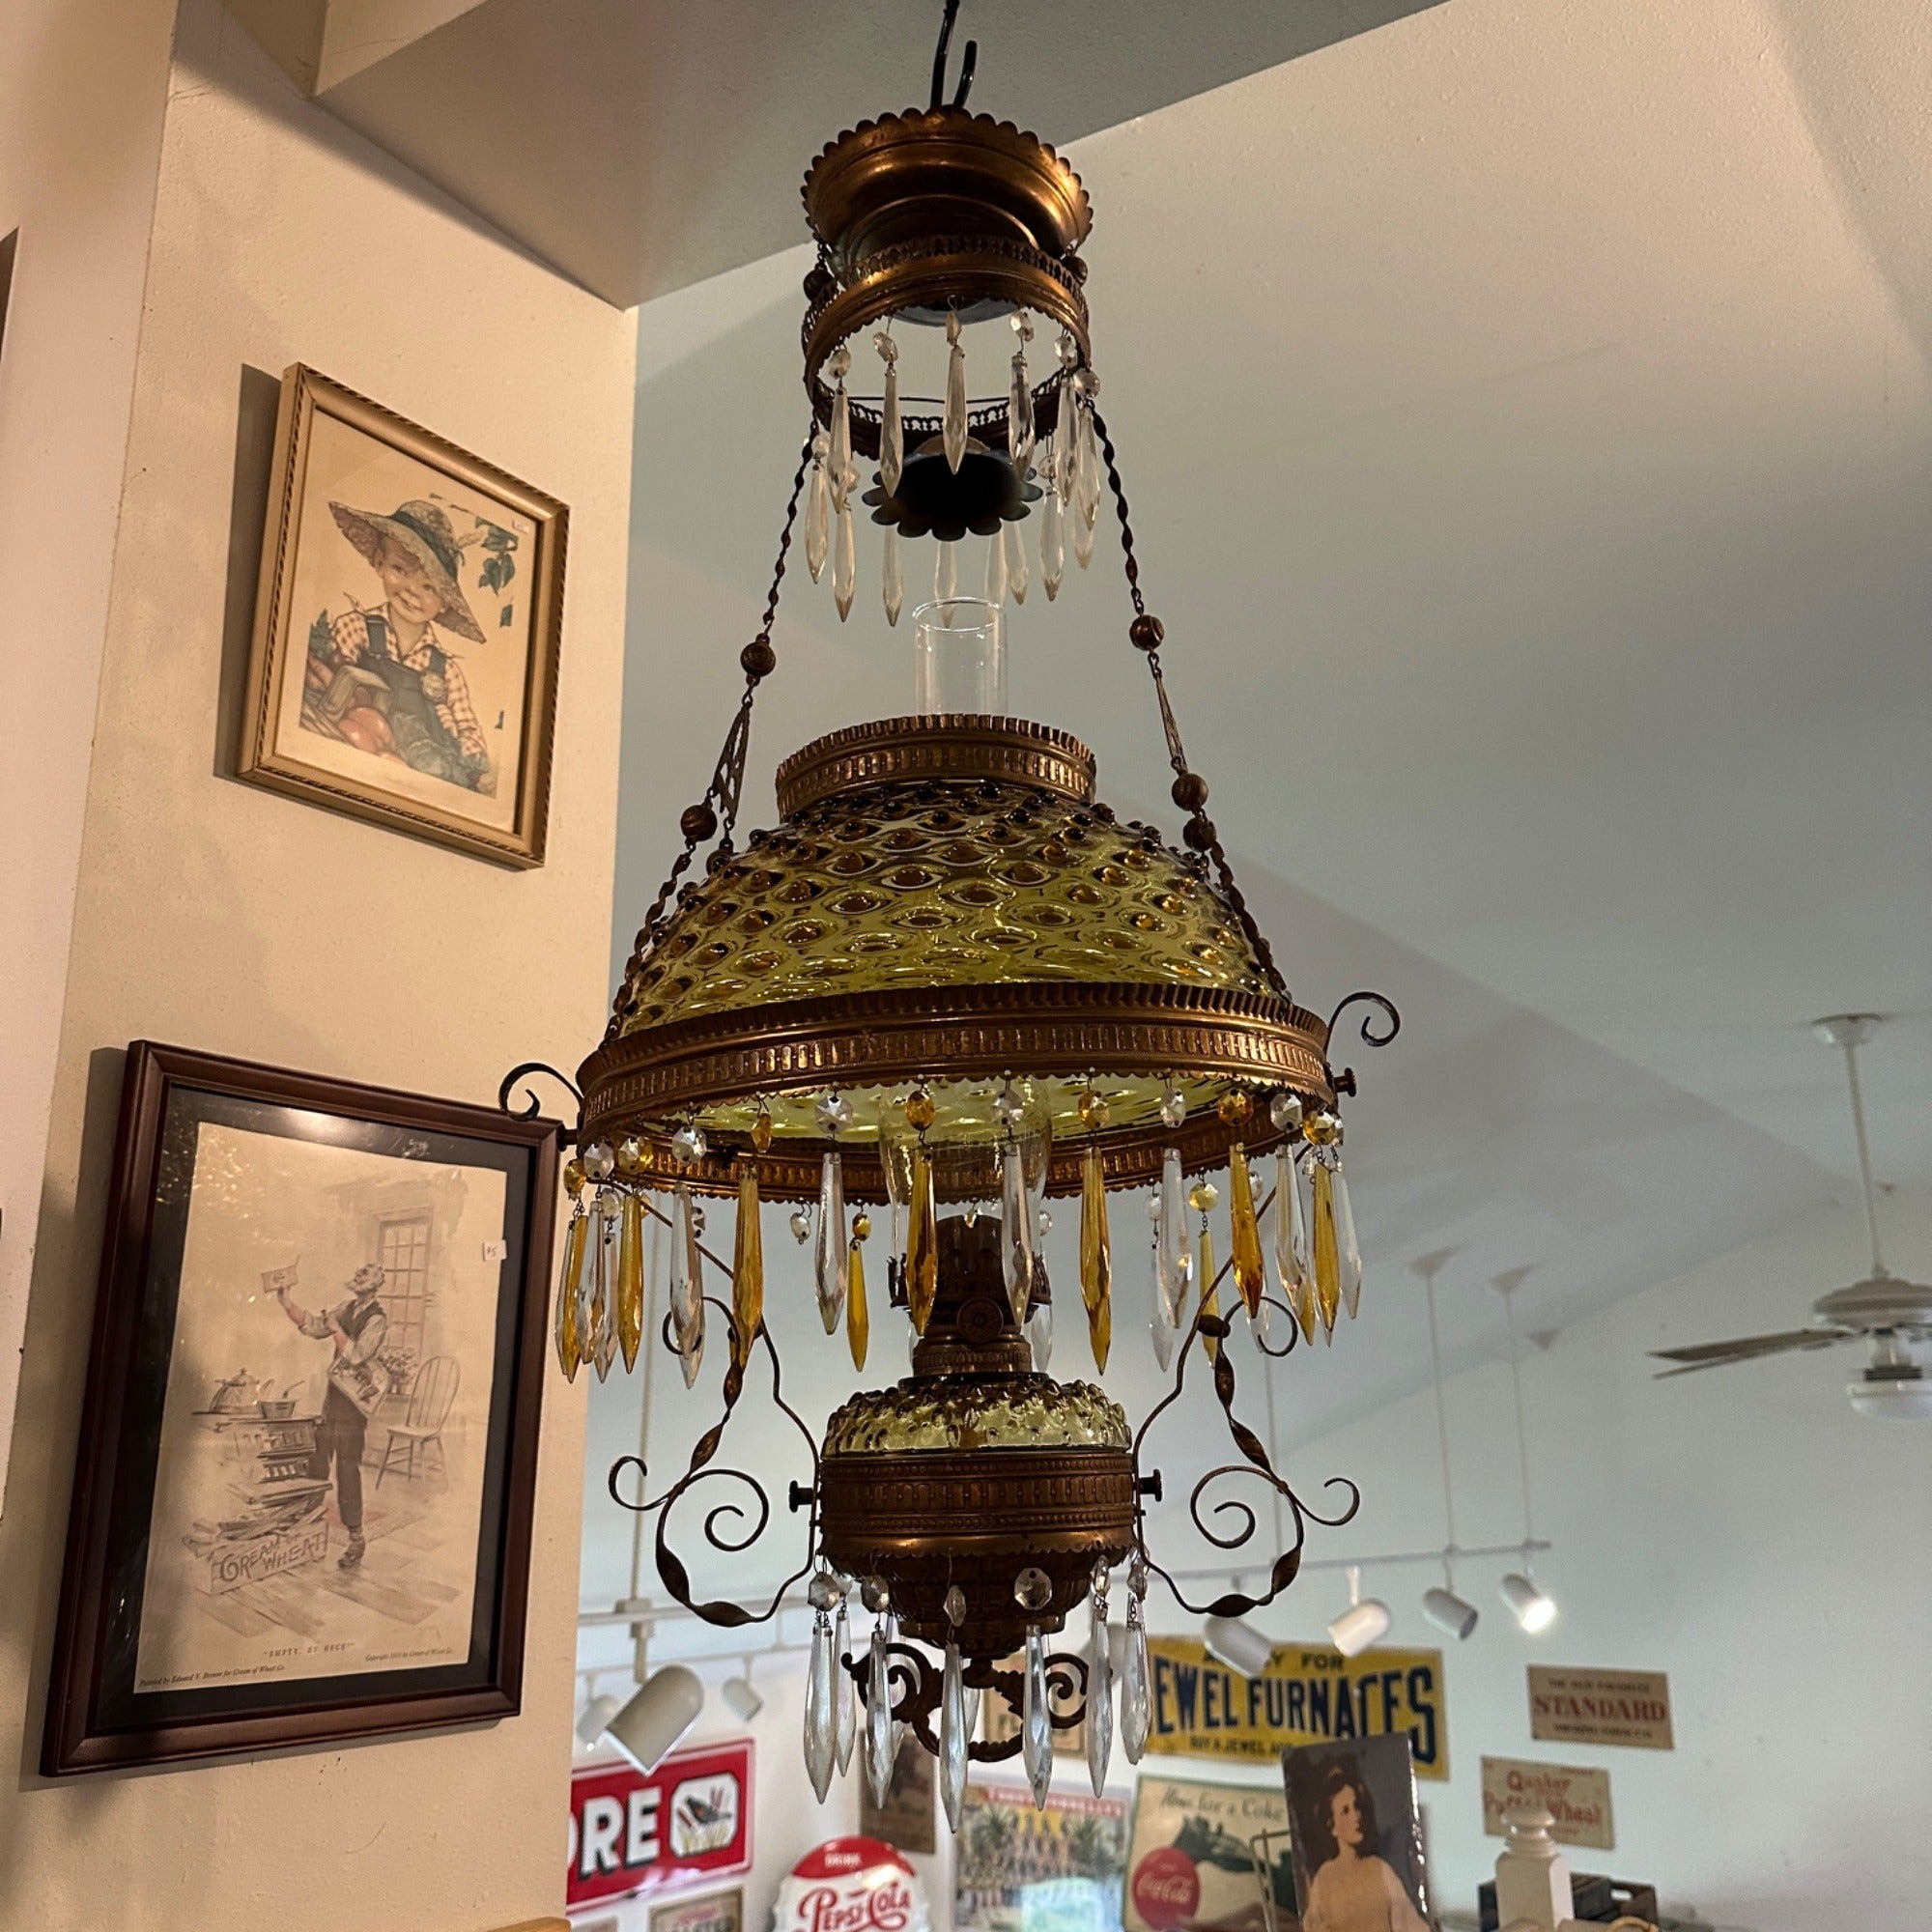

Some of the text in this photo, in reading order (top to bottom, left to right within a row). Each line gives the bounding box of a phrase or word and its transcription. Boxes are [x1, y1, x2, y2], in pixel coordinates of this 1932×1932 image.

[263, 1531, 324, 1572] WHEAT
[1301, 1652, 1346, 1670] FOR
[171, 1673, 194, 1684] Edward
[252, 1665, 259, 1674] of
[259, 1664, 276, 1673] Wheat
[1153, 1656, 1237, 1735] EWEL
[1534, 1695, 1668, 1722] STANDARD
[1506, 1769, 1572, 1794] Quaker
[1241, 1797, 1284, 1822] Coke
[568, 1786, 662, 1875] RE
[824, 1852, 861, 1868] DRINK
